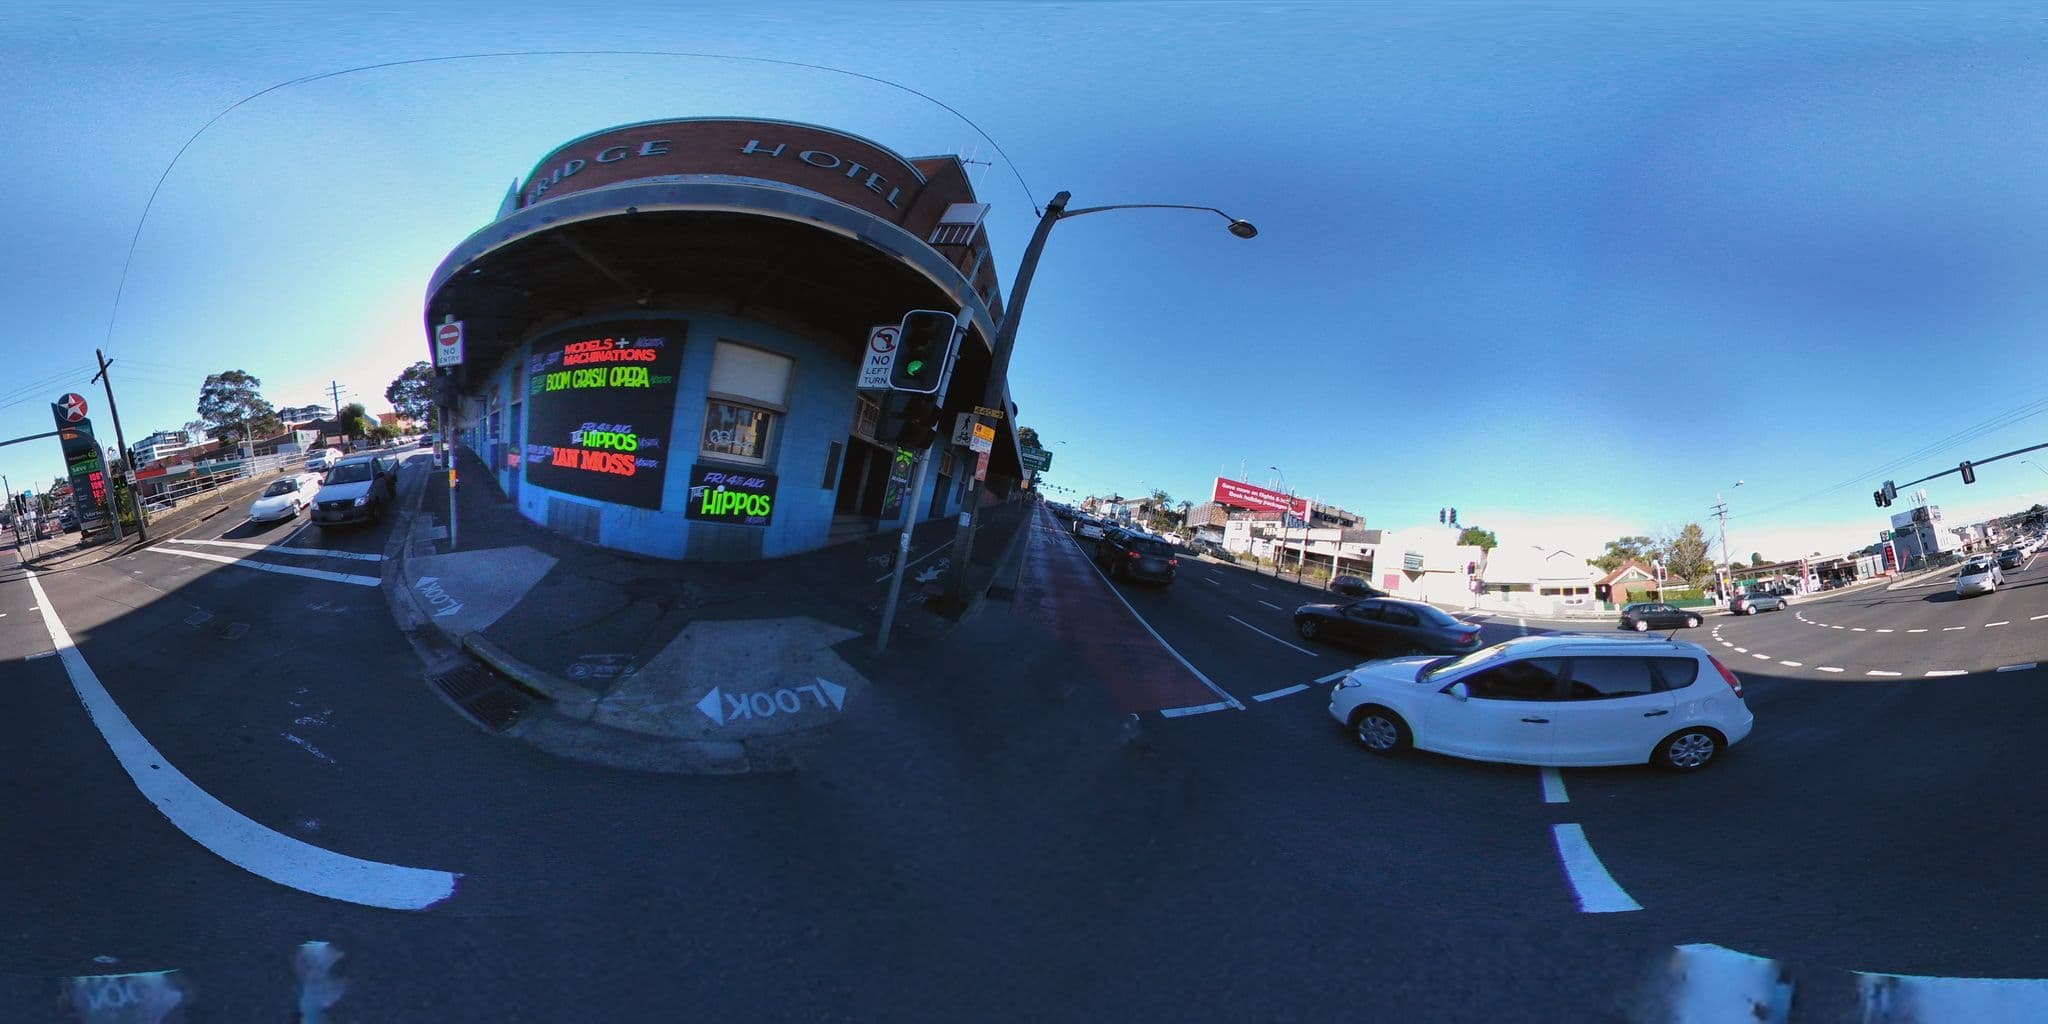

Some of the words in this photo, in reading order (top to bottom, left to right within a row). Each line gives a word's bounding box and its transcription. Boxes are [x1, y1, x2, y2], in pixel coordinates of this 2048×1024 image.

[739, 139, 903, 209] HOTEL
[443, 347, 456, 355] NO
[564, 338, 615, 354] MODELS
[439, 355, 460, 364] ENTRY
[563, 348, 657, 366] MACHINATIONS
[871, 355, 890, 366] NO
[546, 370, 571, 392] BOOM
[572, 367, 608, 389] CRASH
[609, 366, 650, 388] OPERA
[865, 367, 888, 375] LEFT
[863, 376, 887, 385] TURN
[581, 422, 597, 432] FRI
[611, 423, 633, 434] AUG
[552, 447, 579, 468] IAN
[580, 450, 636, 477] MOSS
[703, 472, 727, 484] FRI
[742, 477, 766, 488] AUG
[419, 582, 459, 612] LOOK
[724, 684, 828, 720] LOOK
